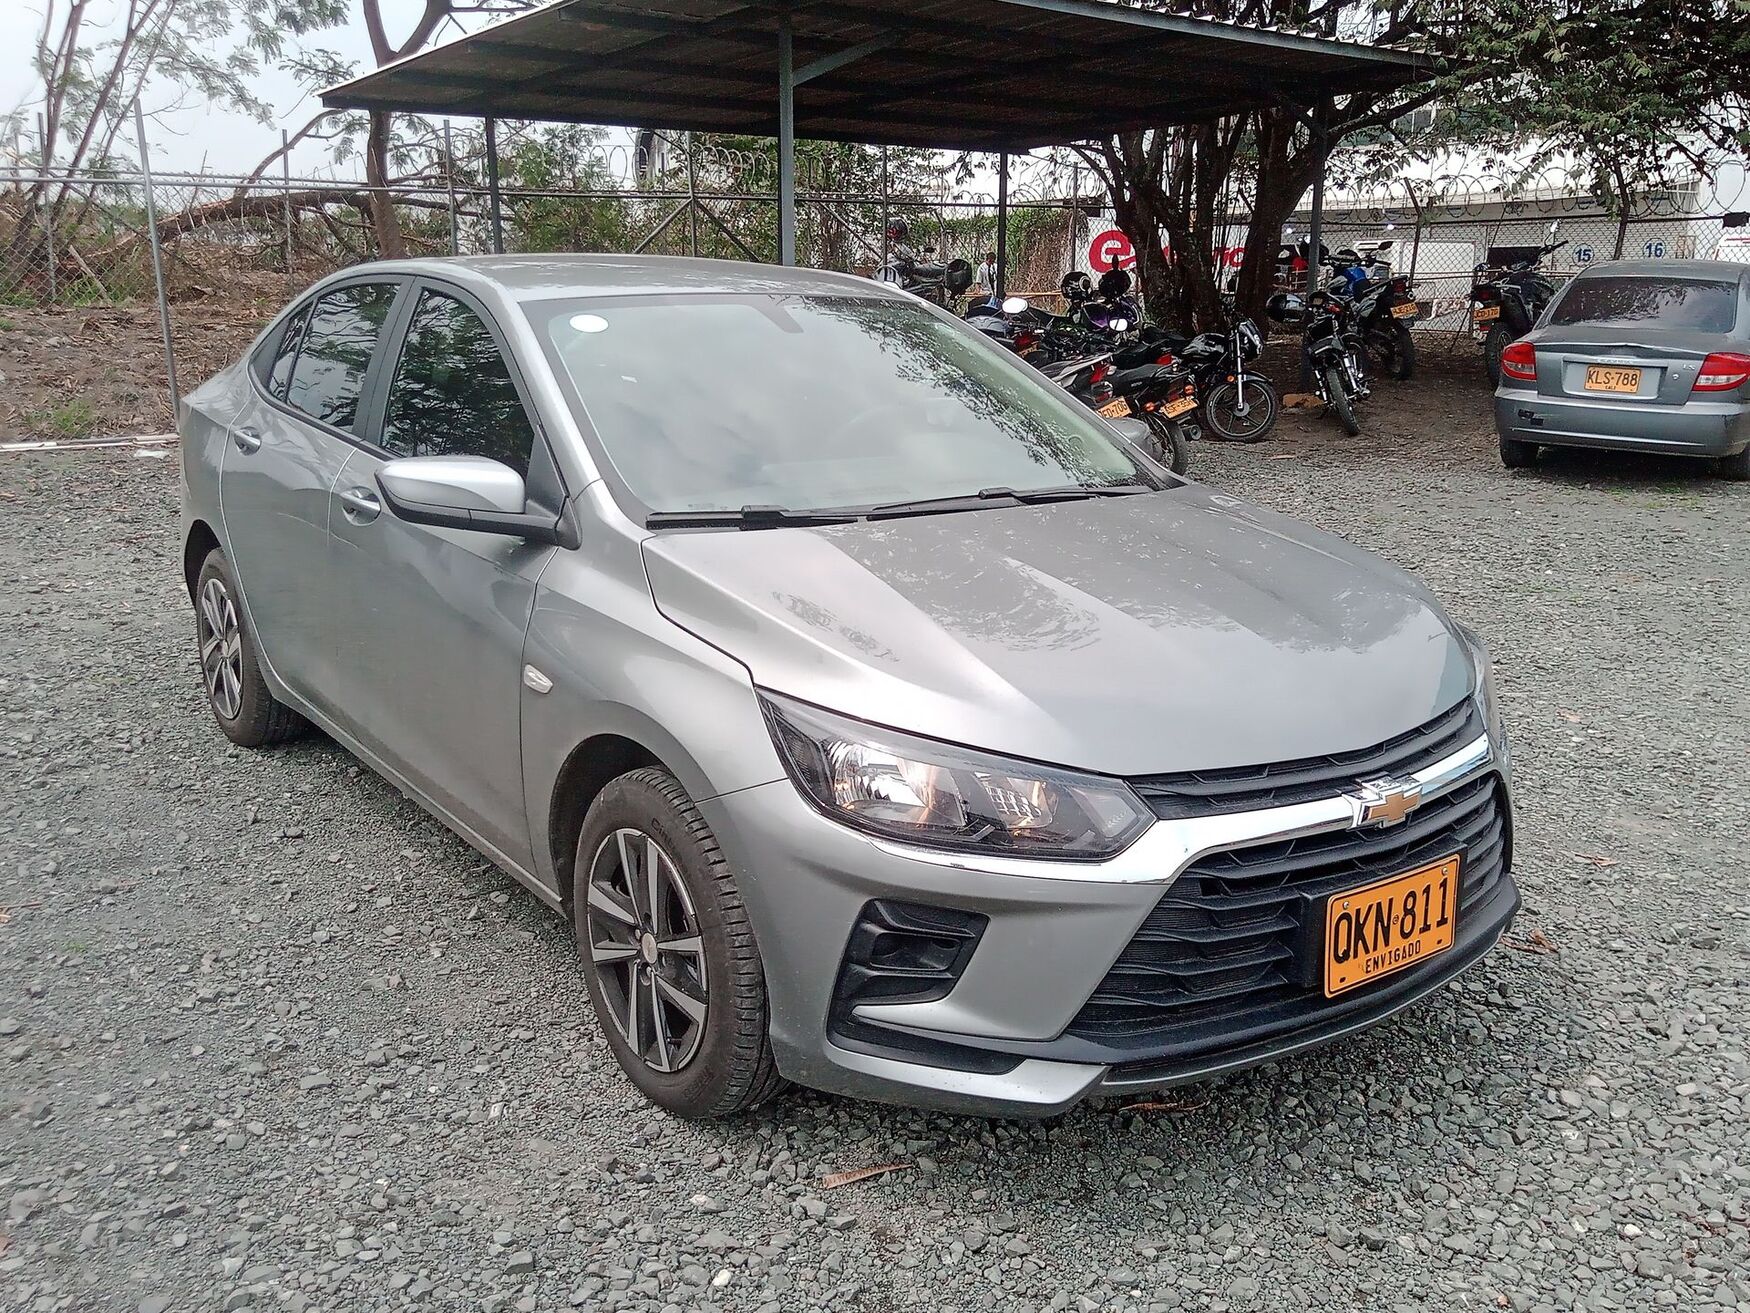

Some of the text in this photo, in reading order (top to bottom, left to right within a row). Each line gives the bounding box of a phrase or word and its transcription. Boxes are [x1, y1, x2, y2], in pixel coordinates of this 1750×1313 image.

[1575, 248, 1592, 263] 15
[1645, 242, 1663, 258] 16
[1365, 940, 1421, 974] ENVIGADO
